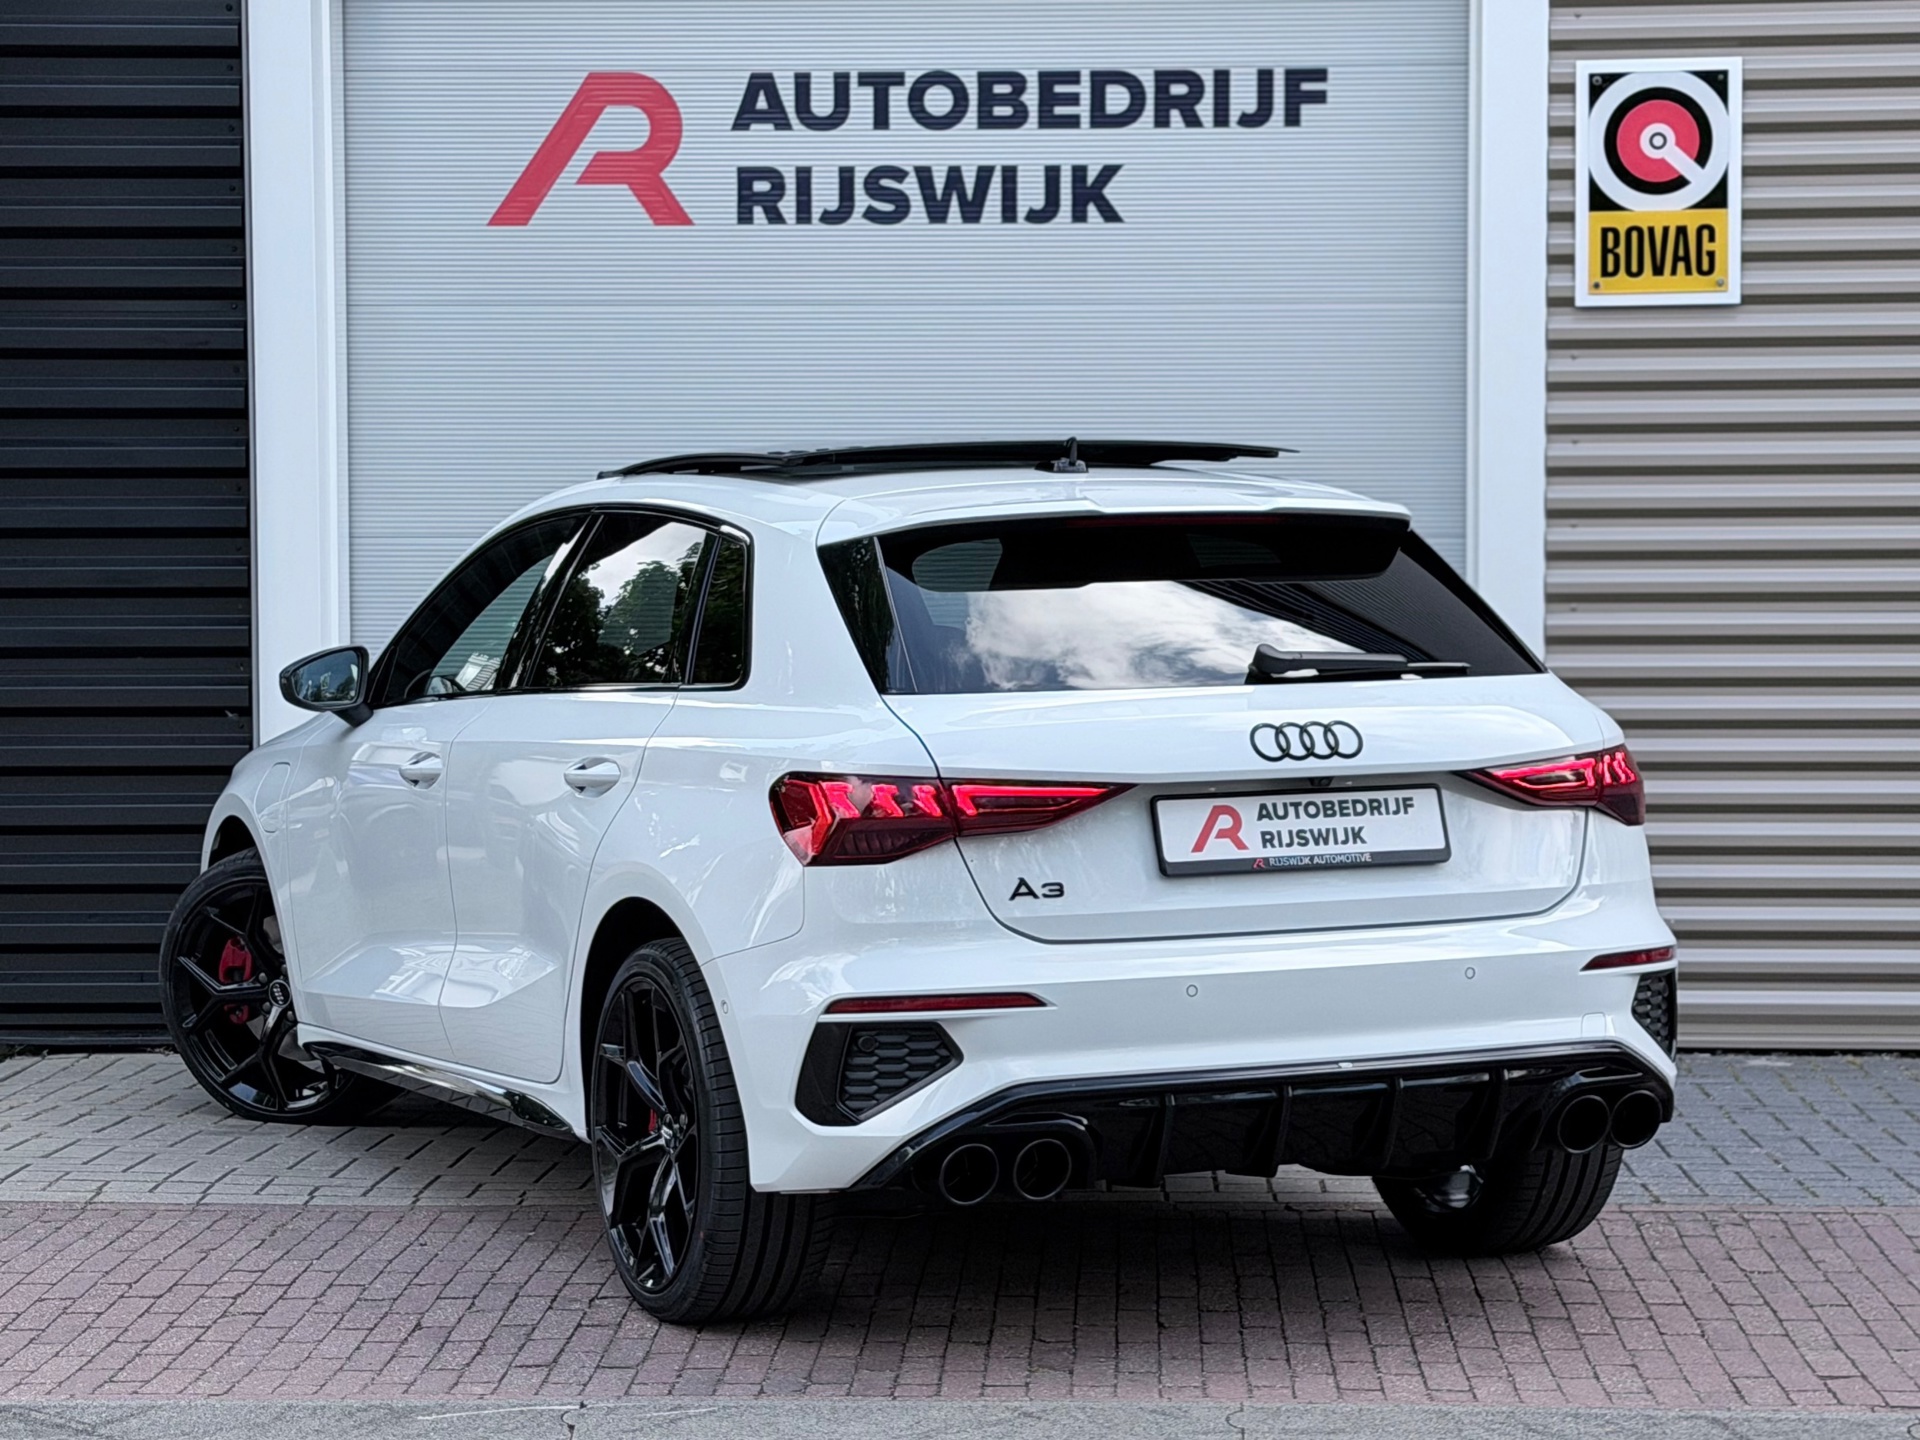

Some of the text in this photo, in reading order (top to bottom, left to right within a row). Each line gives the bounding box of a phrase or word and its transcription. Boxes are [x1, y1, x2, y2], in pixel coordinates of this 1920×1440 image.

[732, 68, 1328, 131] AUTOBEDRIJF
[736, 164, 1124, 225] RIJSWIJK
[1600, 224, 1716, 278] BOVAG
[1256, 797, 1415, 821] AUTOBEDRIJF
[1260, 826, 1367, 849] RIJSWIJK
[1269, 855, 1312, 867] RIJSWIJK
[1313, 852, 1372, 864] AUTOMOTIVE
[1008, 877, 1064, 901] A3
